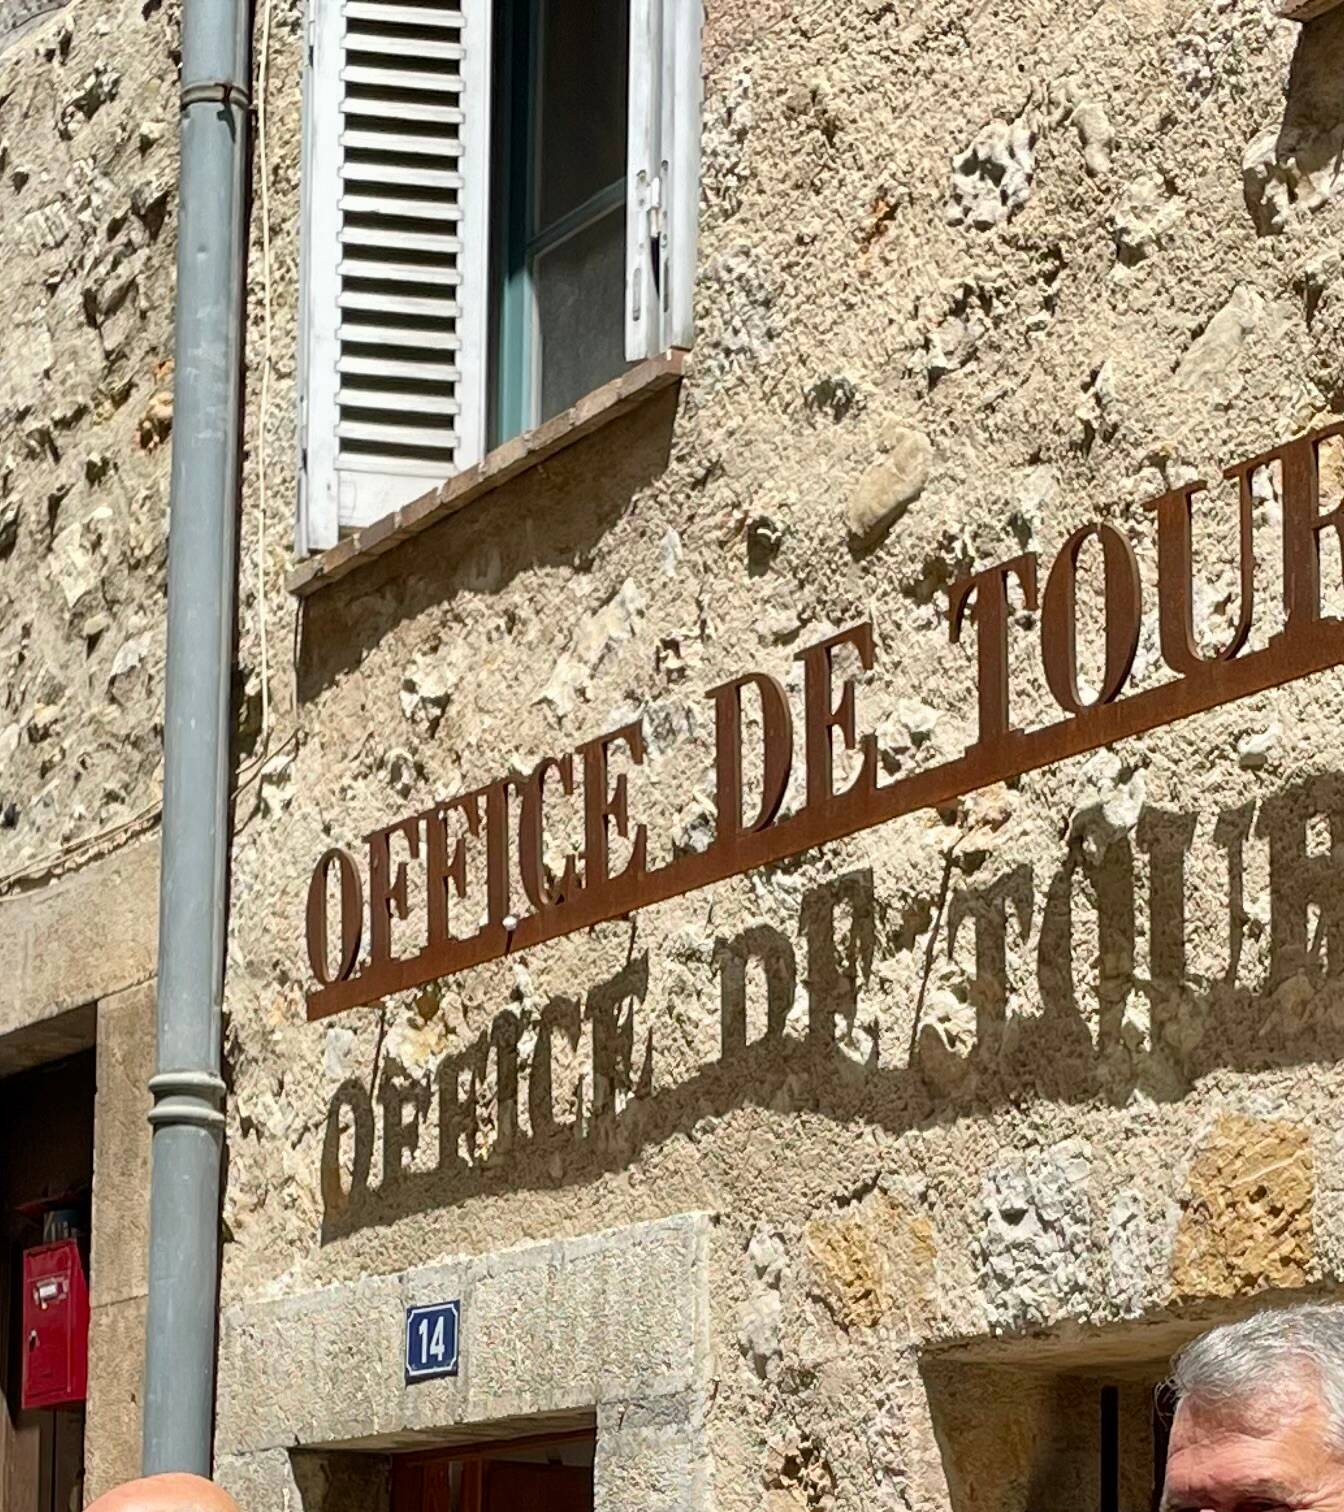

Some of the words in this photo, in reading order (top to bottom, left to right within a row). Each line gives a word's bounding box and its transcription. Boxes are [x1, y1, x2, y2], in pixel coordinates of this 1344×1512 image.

[306, 720, 649, 988] OFFICE
[705, 622, 878, 840] DE
[419, 1316, 445, 1363] 14
